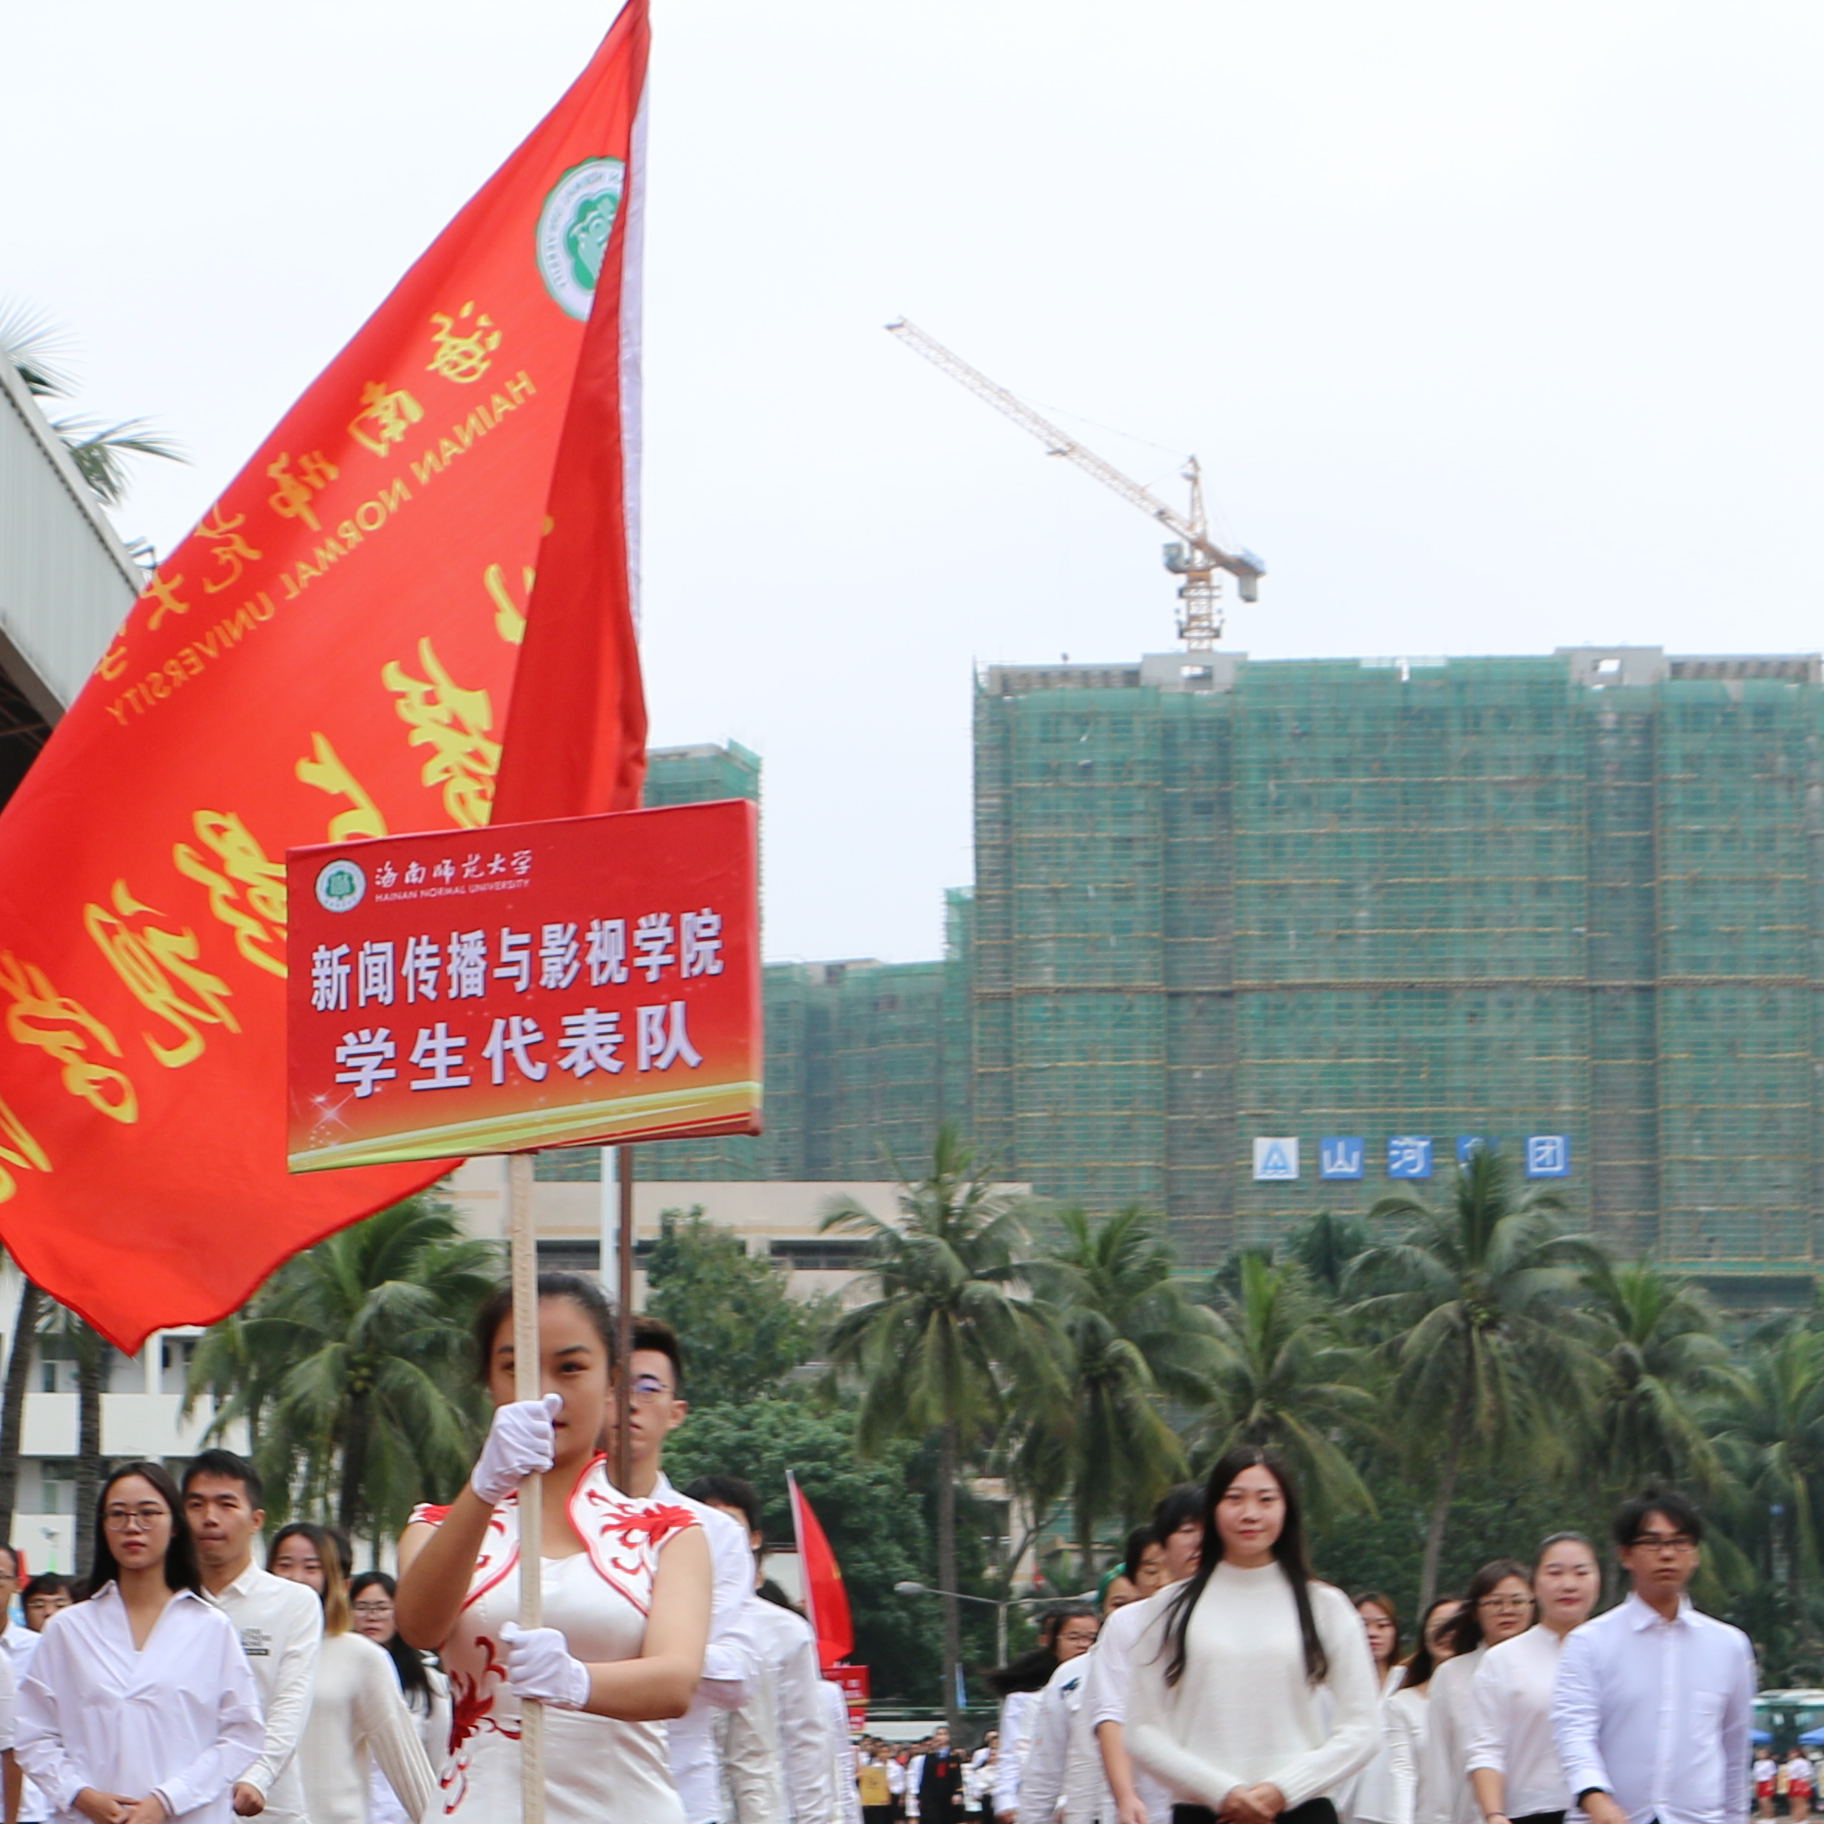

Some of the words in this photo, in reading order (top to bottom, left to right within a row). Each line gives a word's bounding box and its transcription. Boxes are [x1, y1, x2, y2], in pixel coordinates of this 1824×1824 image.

[374, 849, 533, 889] 海南师范大学
[374, 889, 418, 903] HAINAN
[419, 886, 466, 899] NORMAL
[468, 879, 531, 895] UNIVERSITY
[310, 906, 724, 1012] 新闻传播与影视学院
[334, 999, 703, 1099] 学生代表队
